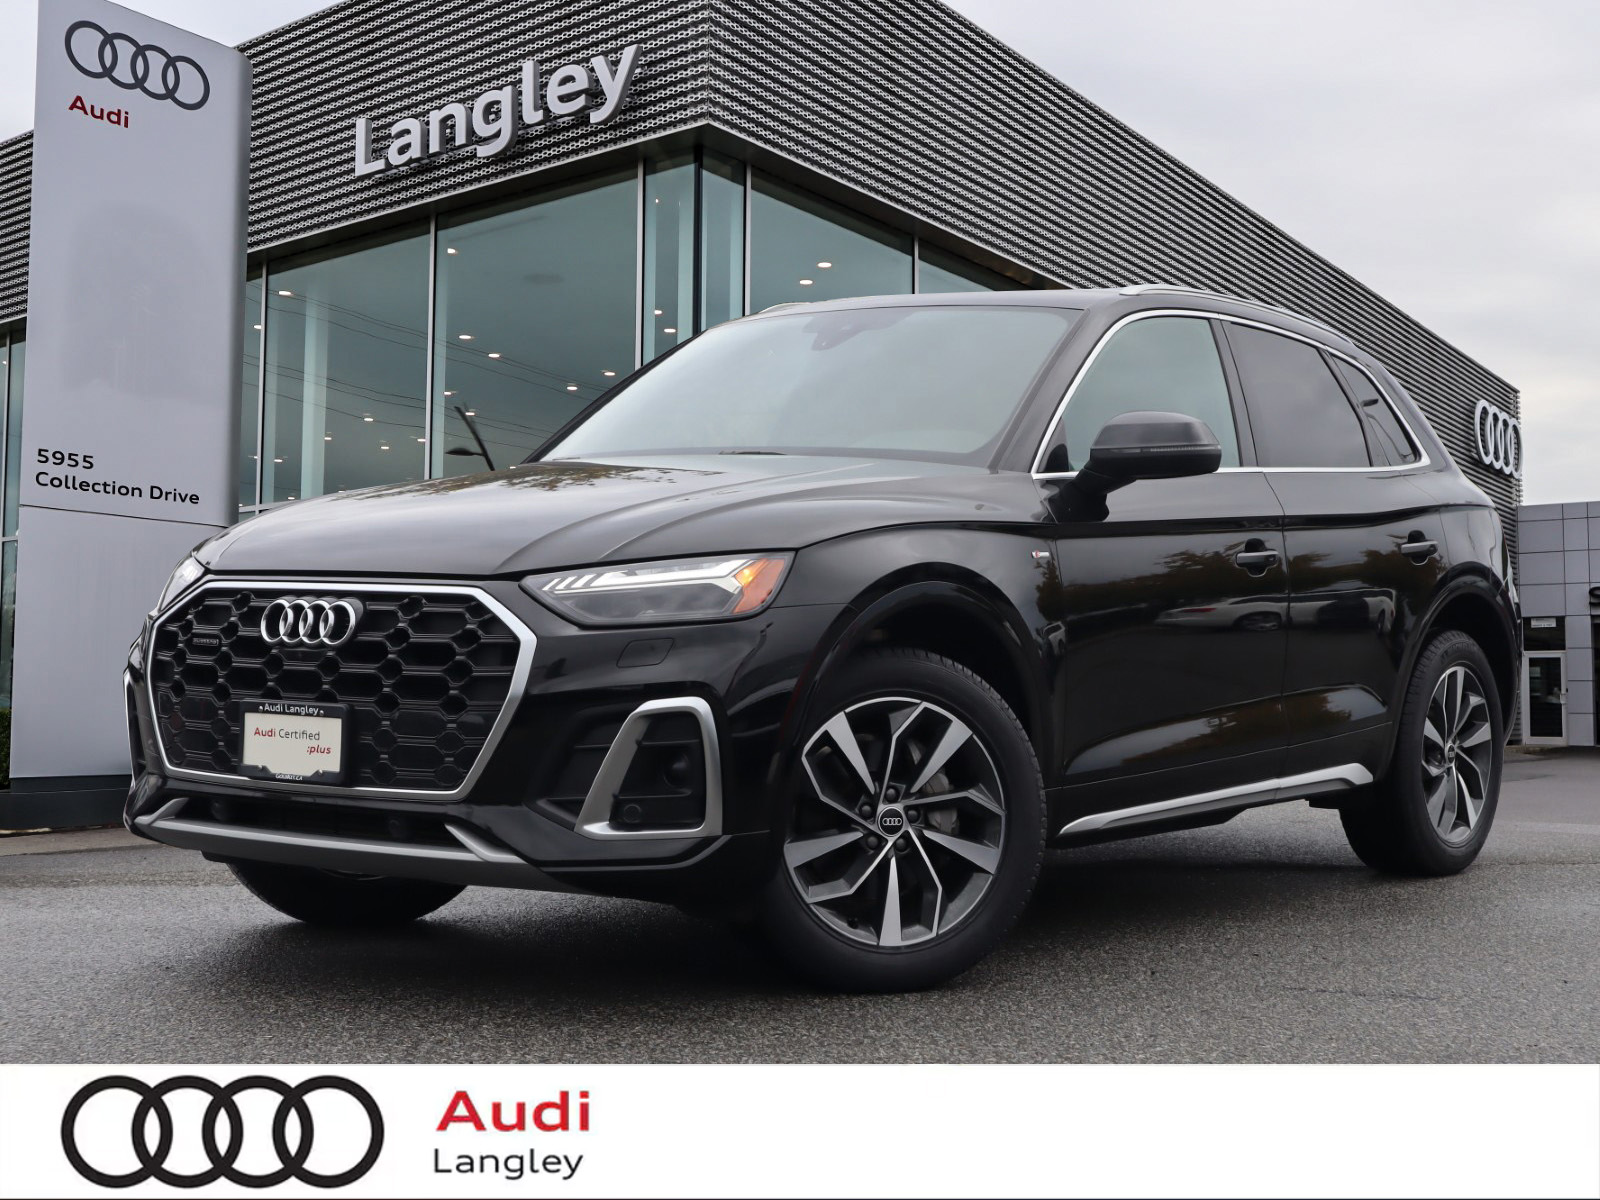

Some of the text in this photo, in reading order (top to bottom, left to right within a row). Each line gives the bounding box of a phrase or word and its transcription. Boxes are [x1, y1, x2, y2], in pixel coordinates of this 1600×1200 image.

[69, 95, 129, 128] Audi
[354, 44, 643, 176] Langley
[37, 448, 94, 469] 5955
[35, 472, 200, 504] Collection Drive
[264, 703, 319, 715] Audi Langley
[254, 727, 320, 740] Audi Certified
